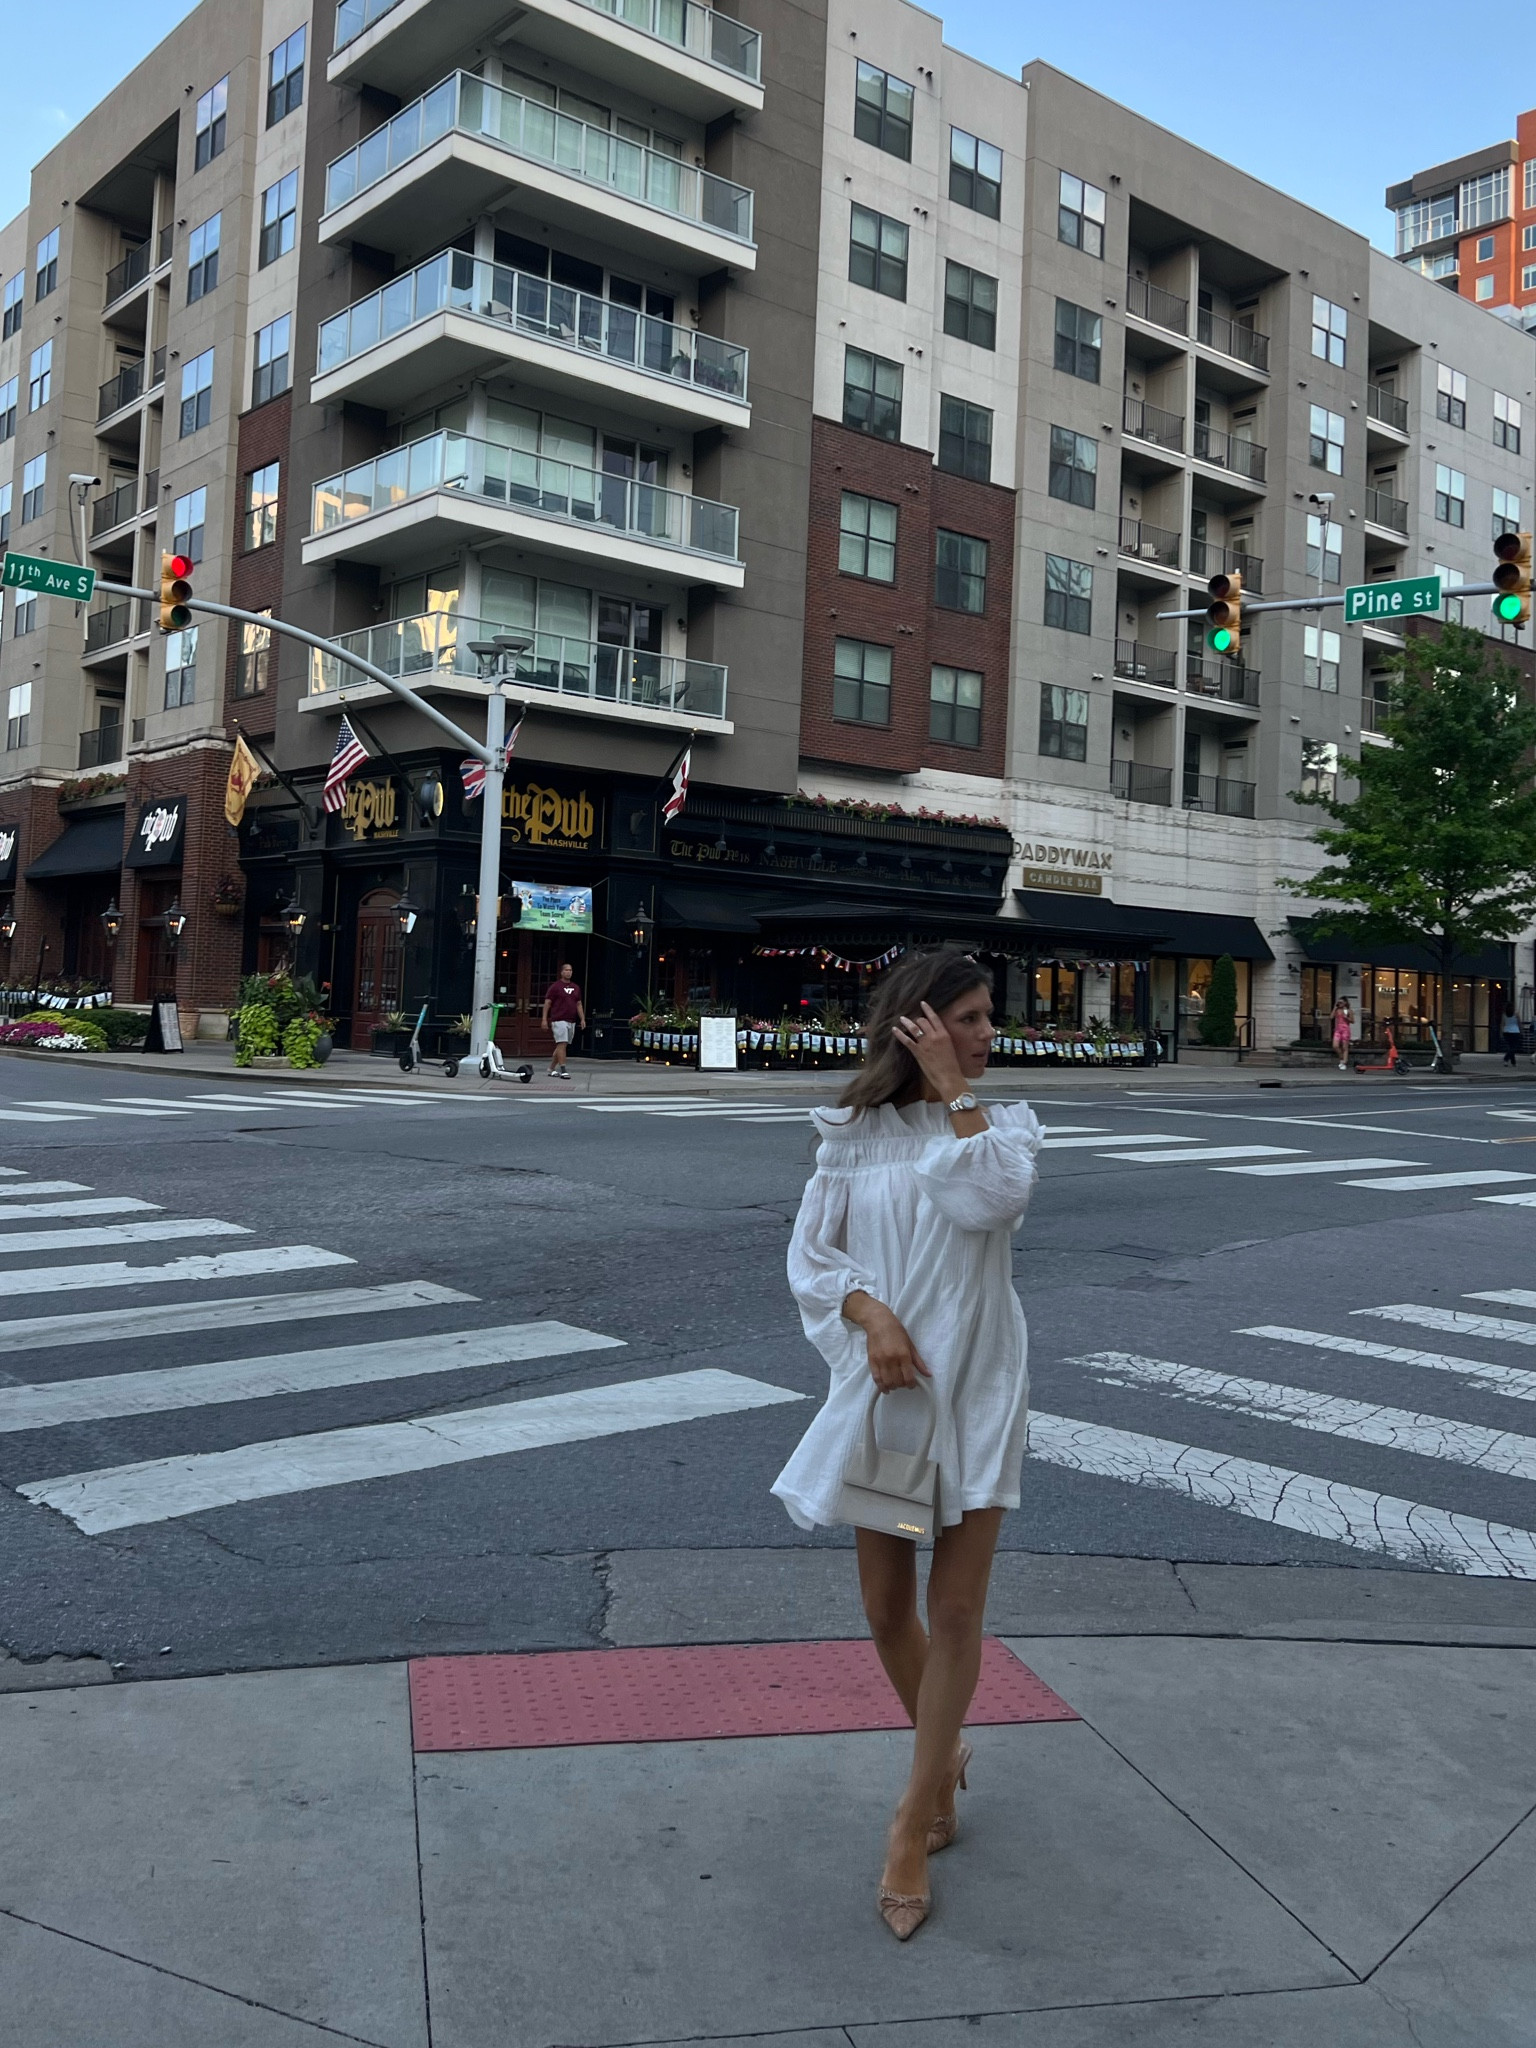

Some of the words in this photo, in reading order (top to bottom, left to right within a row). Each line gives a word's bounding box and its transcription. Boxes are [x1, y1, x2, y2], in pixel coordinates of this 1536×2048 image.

[10, 562, 41, 581] 11th
[45, 574, 71, 590] Ave
[77, 576, 88, 593] S
[1352, 590, 1402, 616] Pine
[353, 776, 396, 841] Pub
[501, 784, 532, 820] the
[524, 783, 594, 845] Pub
[144, 804, 179, 852] Pub
[547, 838, 589, 850] NASHVILLE
[670, 839, 694, 858] The
[696, 842, 722, 862] Pub
[759, 852, 839, 874] NASHVILLE
[1011, 841, 1113, 871] PADDYWAX
[1029, 872, 1074, 888] CANDLE
[1077, 876, 1099, 890] BAR
